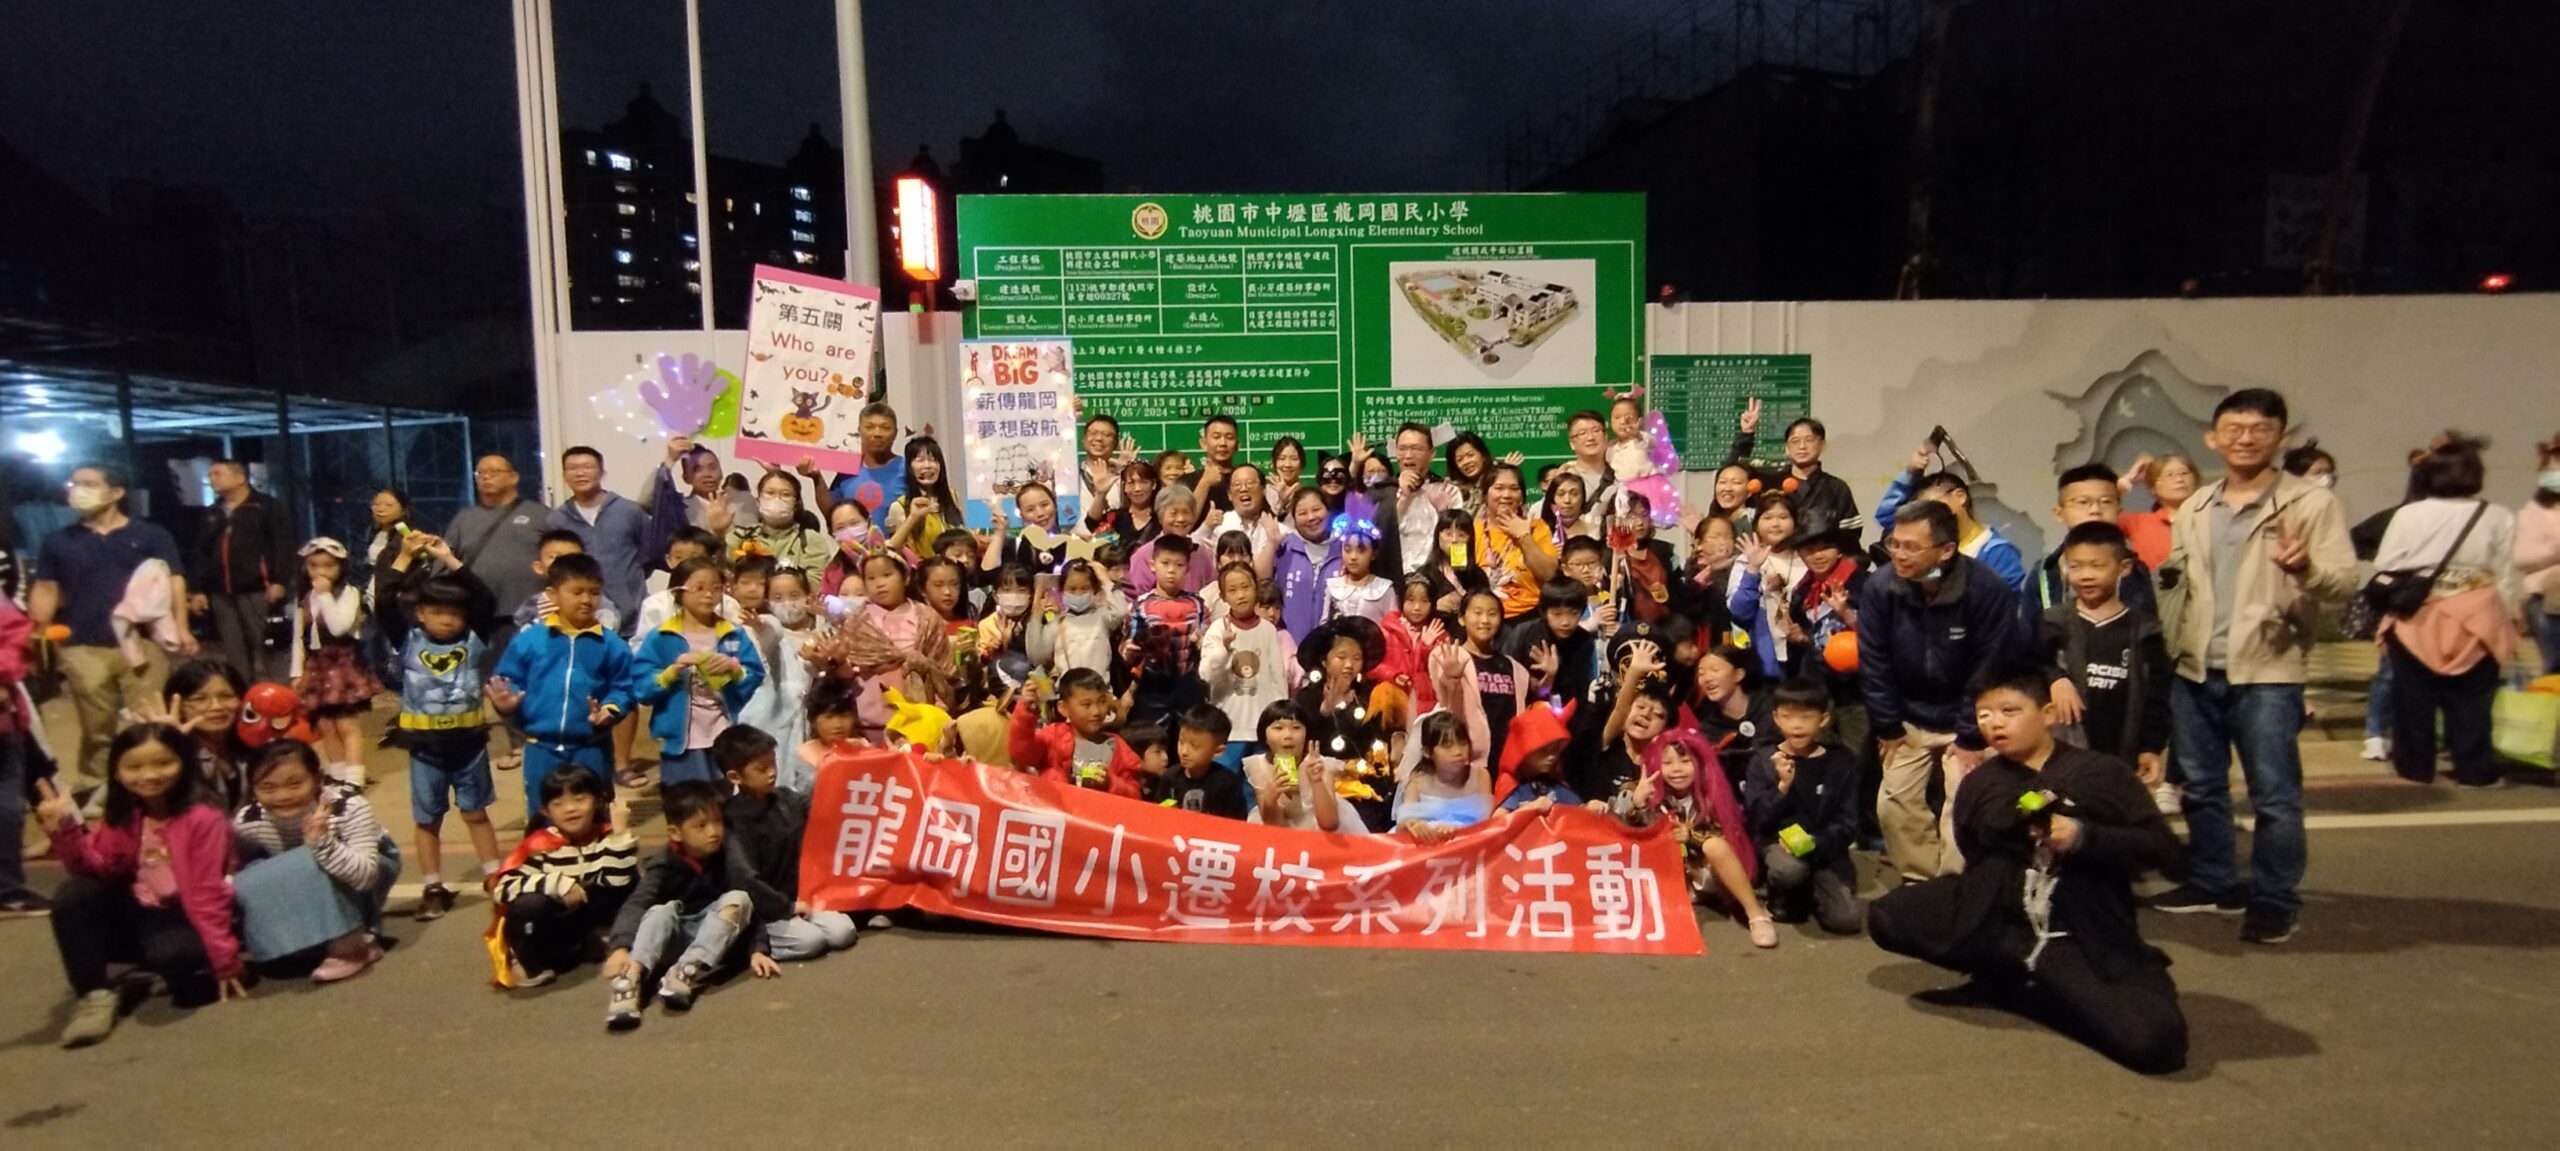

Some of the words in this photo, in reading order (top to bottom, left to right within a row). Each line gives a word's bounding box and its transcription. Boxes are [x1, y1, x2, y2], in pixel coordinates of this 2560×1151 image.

[1192, 200, 1470, 225] 桃園市中壢區龍岡國民小學
[1178, 225, 1233, 240] Taoyuan
[1237, 225, 1301, 239] Municipal
[1305, 225, 1365, 239] Longxing
[1368, 224, 1440, 237] Elementary
[1443, 223, 1484, 236] School
[1187, 282, 1218, 293] 設計人
[778, 303, 843, 332] 第五關
[771, 331, 815, 353] Who
[825, 345, 856, 361] are
[992, 345, 1038, 361] DRAM
[783, 366, 830, 384] you?
[976, 391, 1058, 411] 薪傳龍岡
[1473, 394, 1493, 403] Price
[1495, 394, 1509, 402] and
[978, 419, 1060, 440] 夢想啟航
[832, 771, 1668, 944] 龍岡國小遷校系列活動
